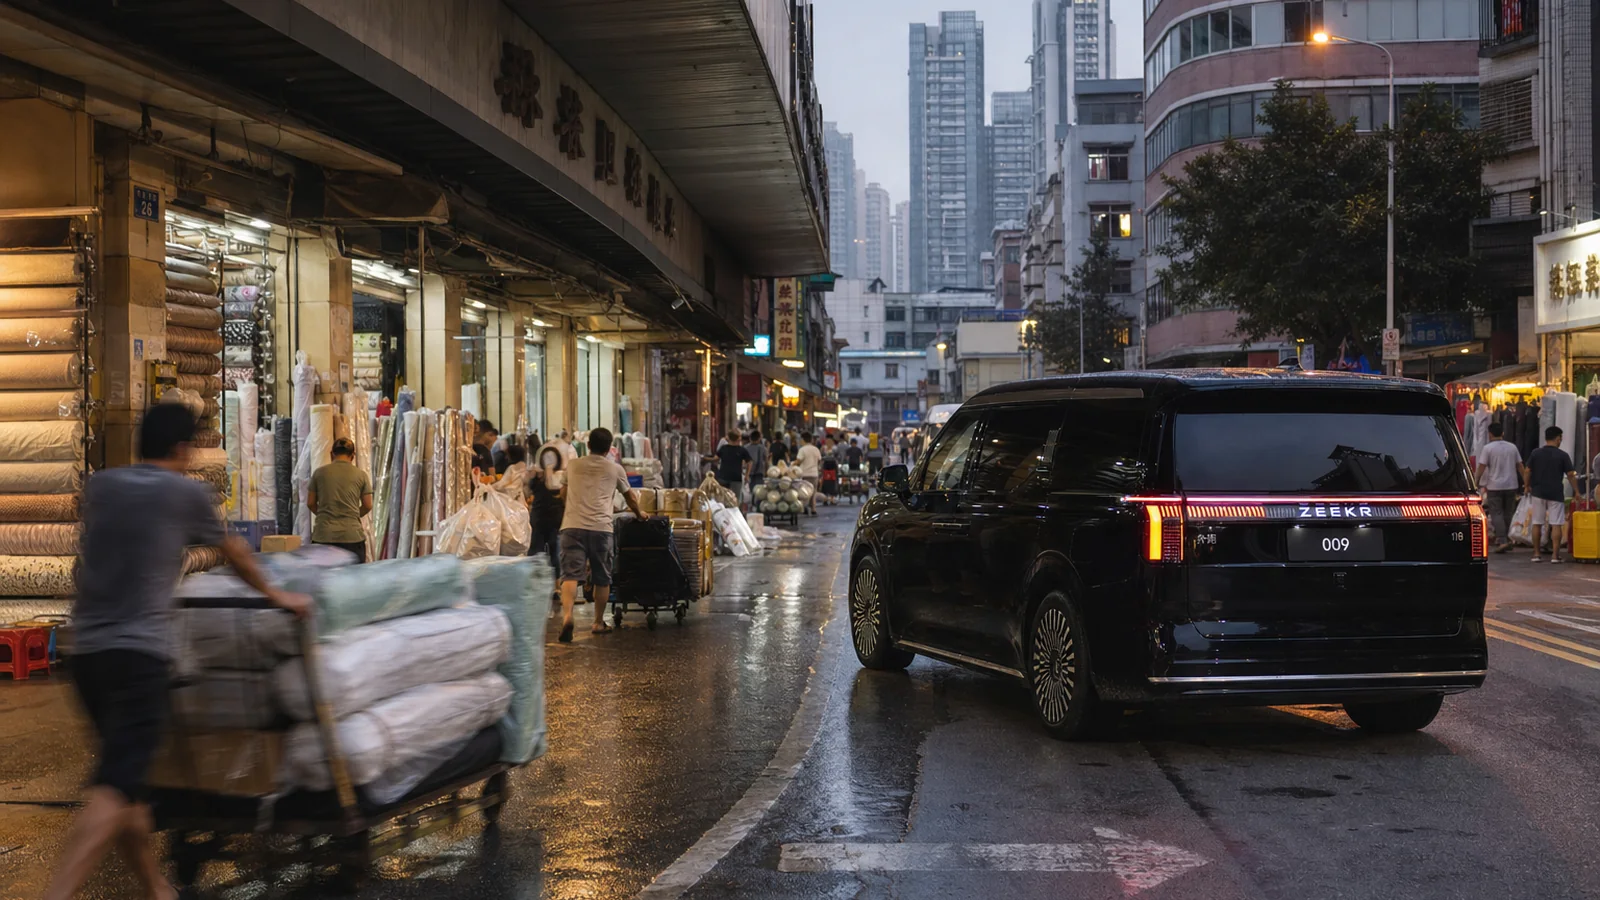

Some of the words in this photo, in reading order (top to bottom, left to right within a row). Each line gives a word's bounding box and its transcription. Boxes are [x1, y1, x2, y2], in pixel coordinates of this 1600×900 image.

[141, 201, 152, 217] 26
[1299, 506, 1372, 518] ZEEKR
[1322, 537, 1350, 552] 009
